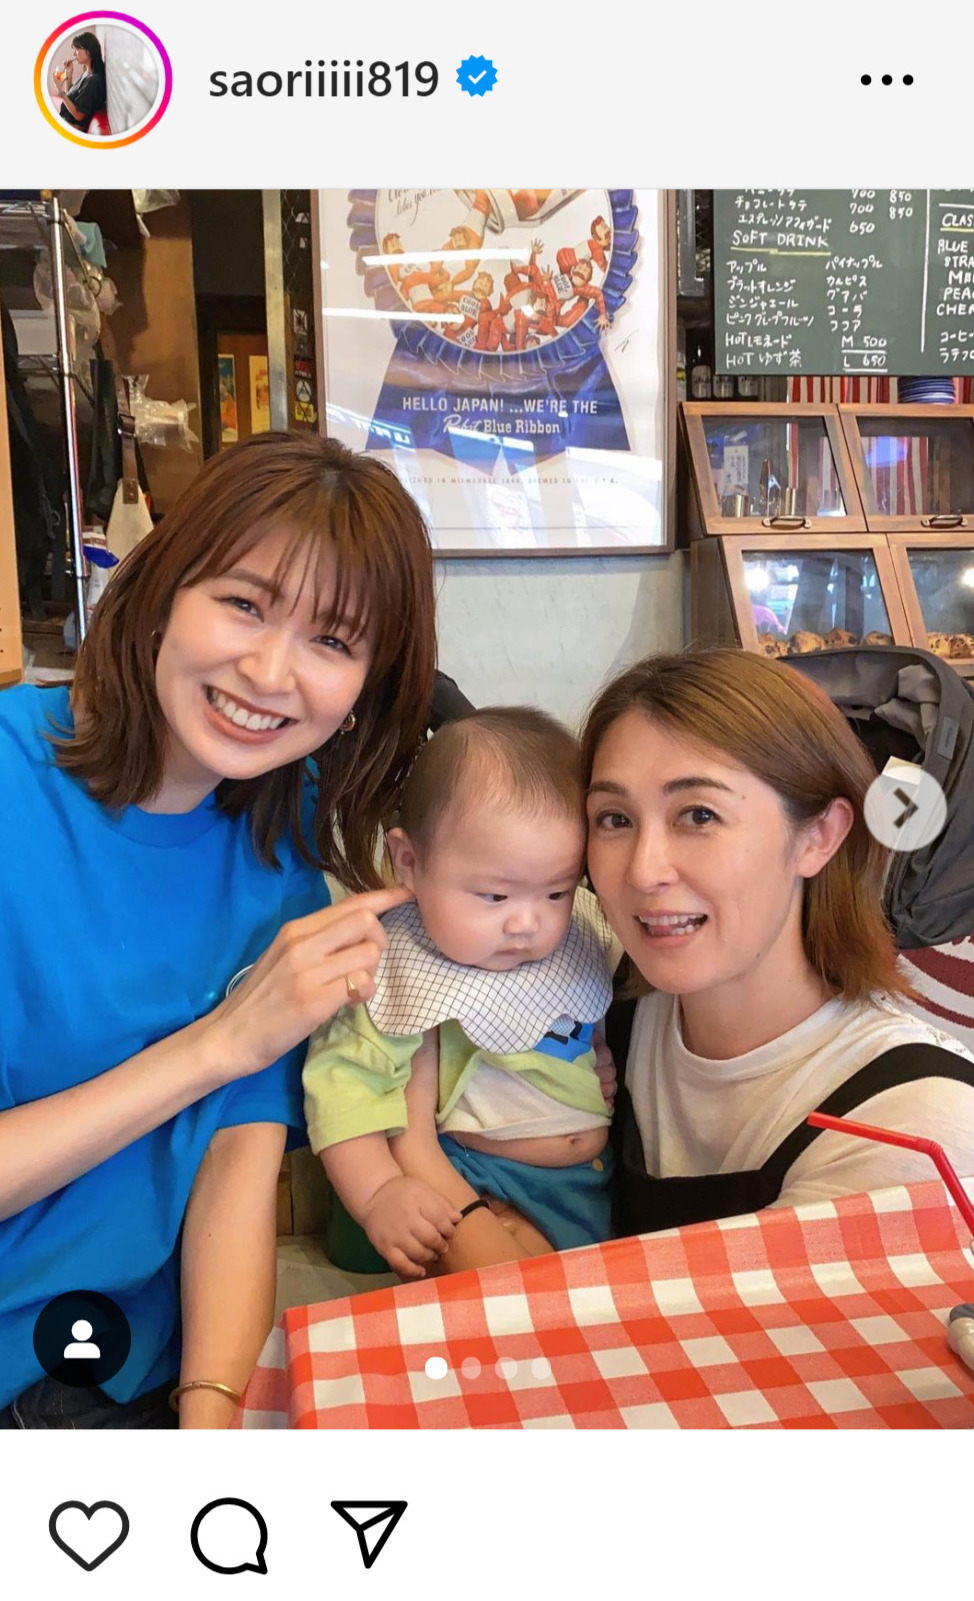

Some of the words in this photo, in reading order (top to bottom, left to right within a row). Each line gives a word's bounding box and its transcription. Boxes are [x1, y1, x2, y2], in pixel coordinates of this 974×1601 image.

[849, 202, 875, 215] 700
[889, 206, 914, 220] 850
[942, 212, 974, 227] CLAS
[849, 221, 876, 235] 650
[777, 232, 829, 248] DRINK
[937, 238, 969, 255] BLUE
[726, 258, 767, 274] アップル
[825, 254, 883, 271] パイナップル
[826, 274, 867, 288] カルピス
[827, 304, 863, 319] コーラ
[841, 334, 854, 348] M
[863, 335, 888, 348] 500
[843, 355, 851, 368] L
[862, 354, 887, 368] 650
[402, 396, 448, 412] HELLO
[453, 397, 505, 413] JAPAN!
[572, 400, 598, 414] THE
[483, 418, 512, 434] Blue
[515, 418, 561, 434] Ribbon
